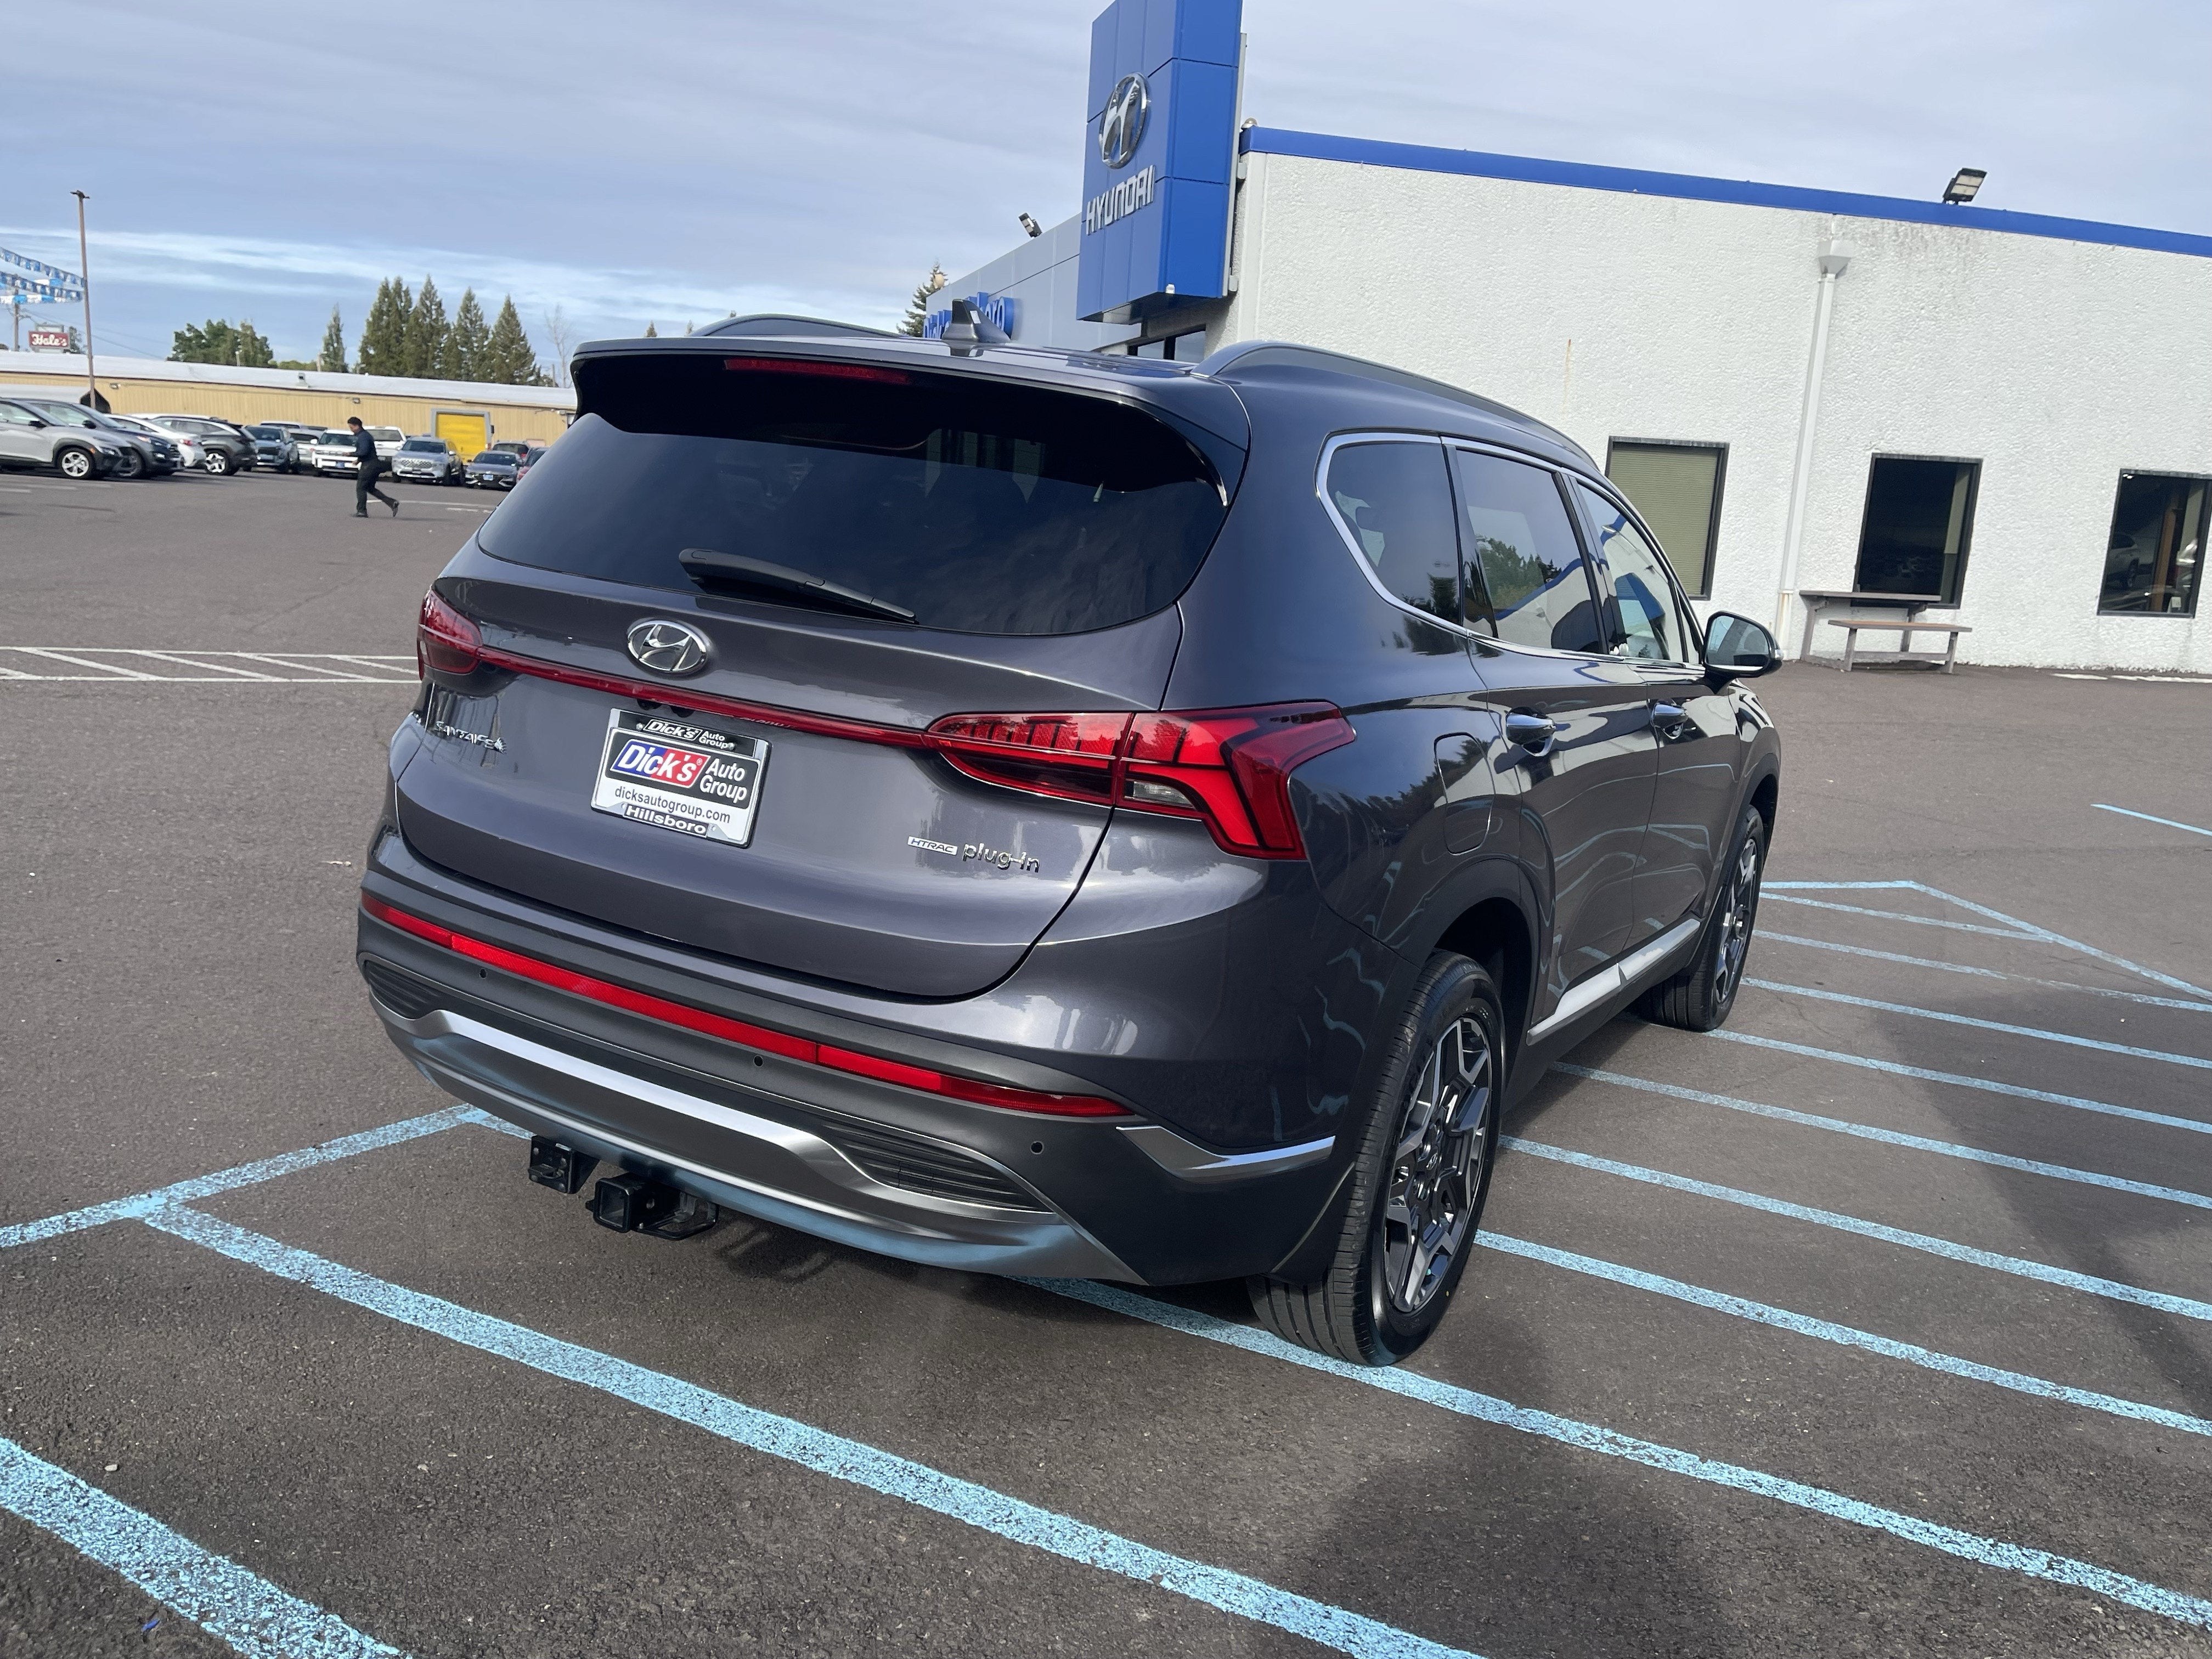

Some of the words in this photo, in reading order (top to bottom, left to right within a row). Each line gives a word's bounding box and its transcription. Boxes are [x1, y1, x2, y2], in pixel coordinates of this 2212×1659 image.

[1086, 165, 1155, 236] HYUNDAI
[647, 721, 695, 739] Dick's
[698, 736, 729, 749] Group
[701, 730, 725, 741] Auto
[617, 744, 697, 782] Dick's
[706, 758, 746, 781] Auto
[699, 774, 747, 804] Group
[614, 786, 731, 823] dicksautogroup.com
[625, 804, 706, 834] Hillsboro
[911, 838, 954, 853] HTRAC
[962, 842, 1040, 873] plug-in
